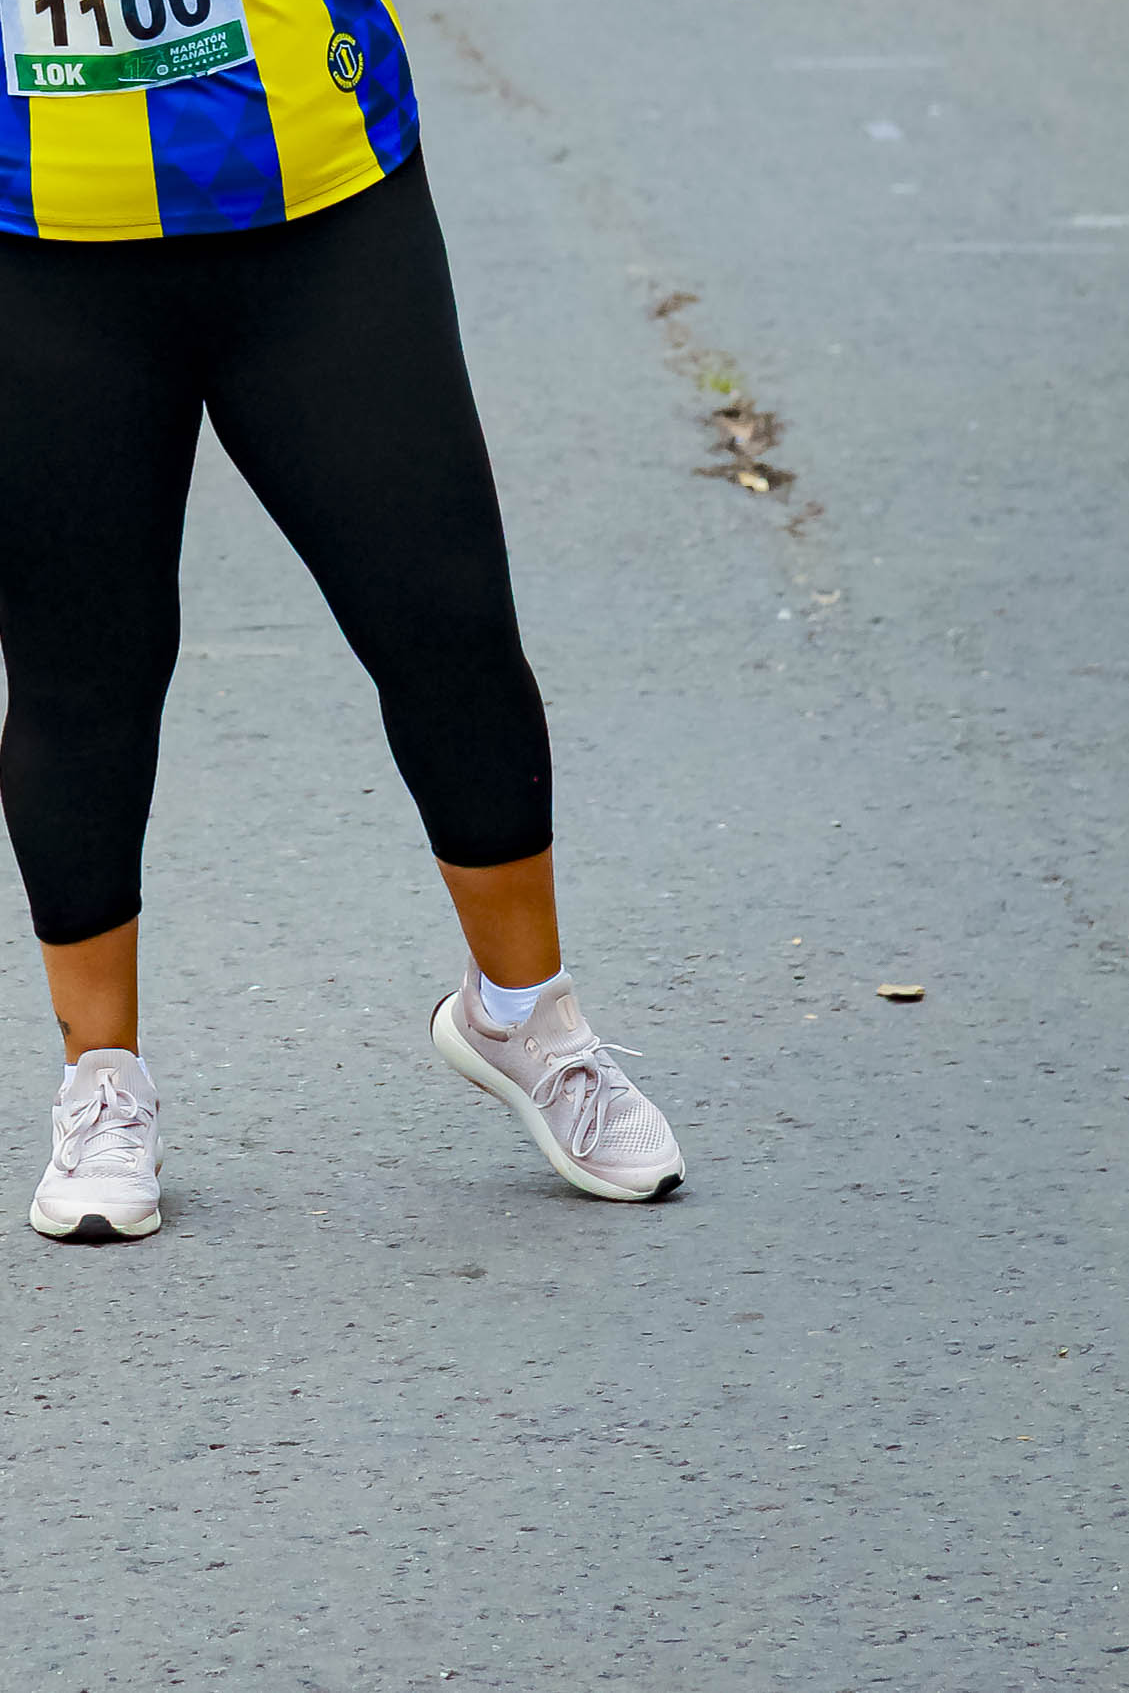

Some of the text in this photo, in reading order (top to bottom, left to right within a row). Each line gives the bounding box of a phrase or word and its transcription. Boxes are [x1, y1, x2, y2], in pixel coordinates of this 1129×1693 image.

[169, 31, 227, 56] MARATÓN
[172, 41, 229, 64] CANALLA
[31, 62, 87, 87] 10K
